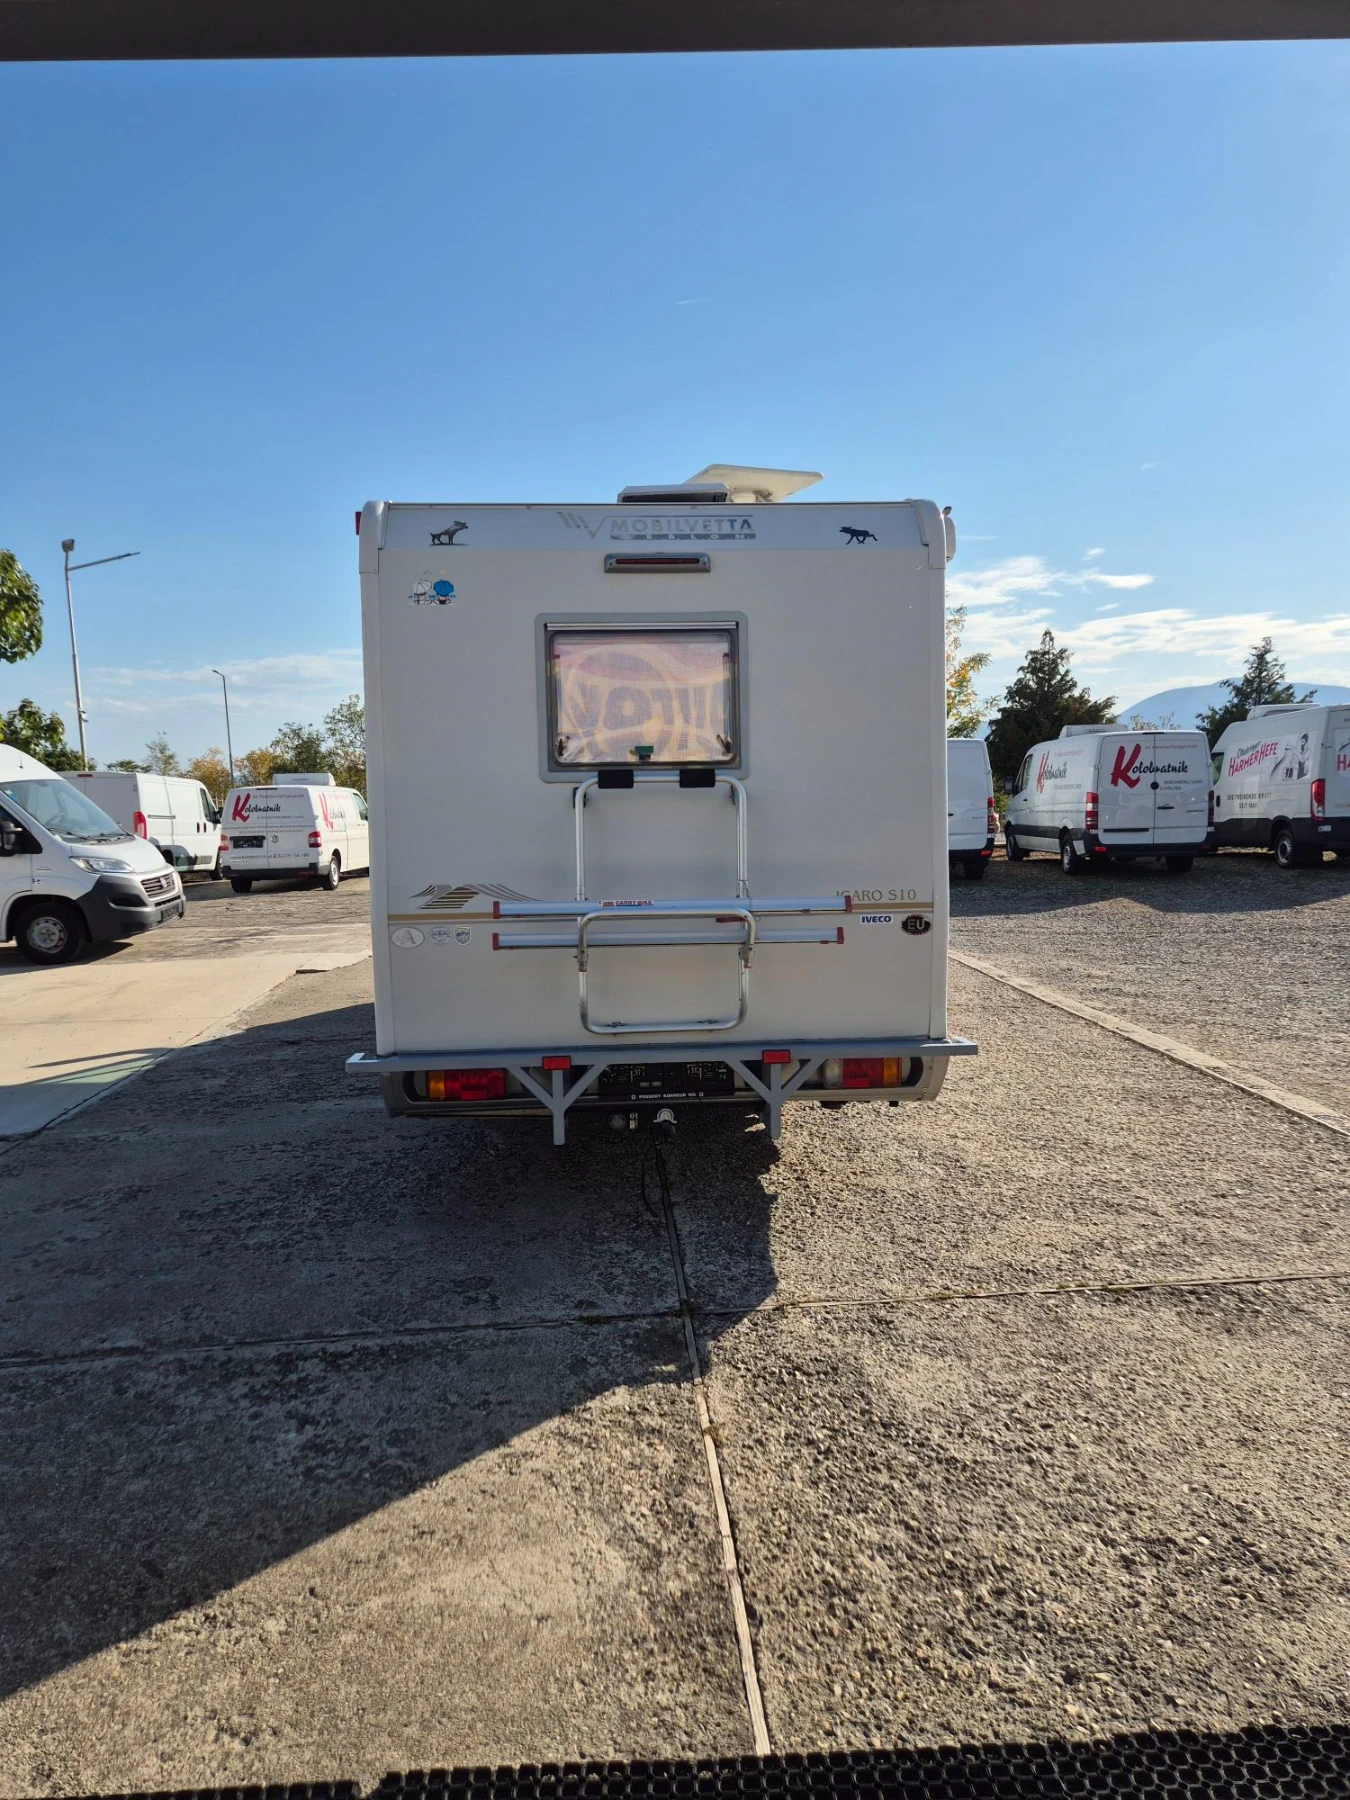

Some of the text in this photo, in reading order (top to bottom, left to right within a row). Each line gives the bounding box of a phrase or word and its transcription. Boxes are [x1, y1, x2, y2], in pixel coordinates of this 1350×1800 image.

[609, 518, 755, 533] MOBILVETTA
[888, 889, 916, 900] S10
[861, 915, 892, 923] IVECO
[907, 919, 925, 930] EU
[401, 929, 417, 945] A
